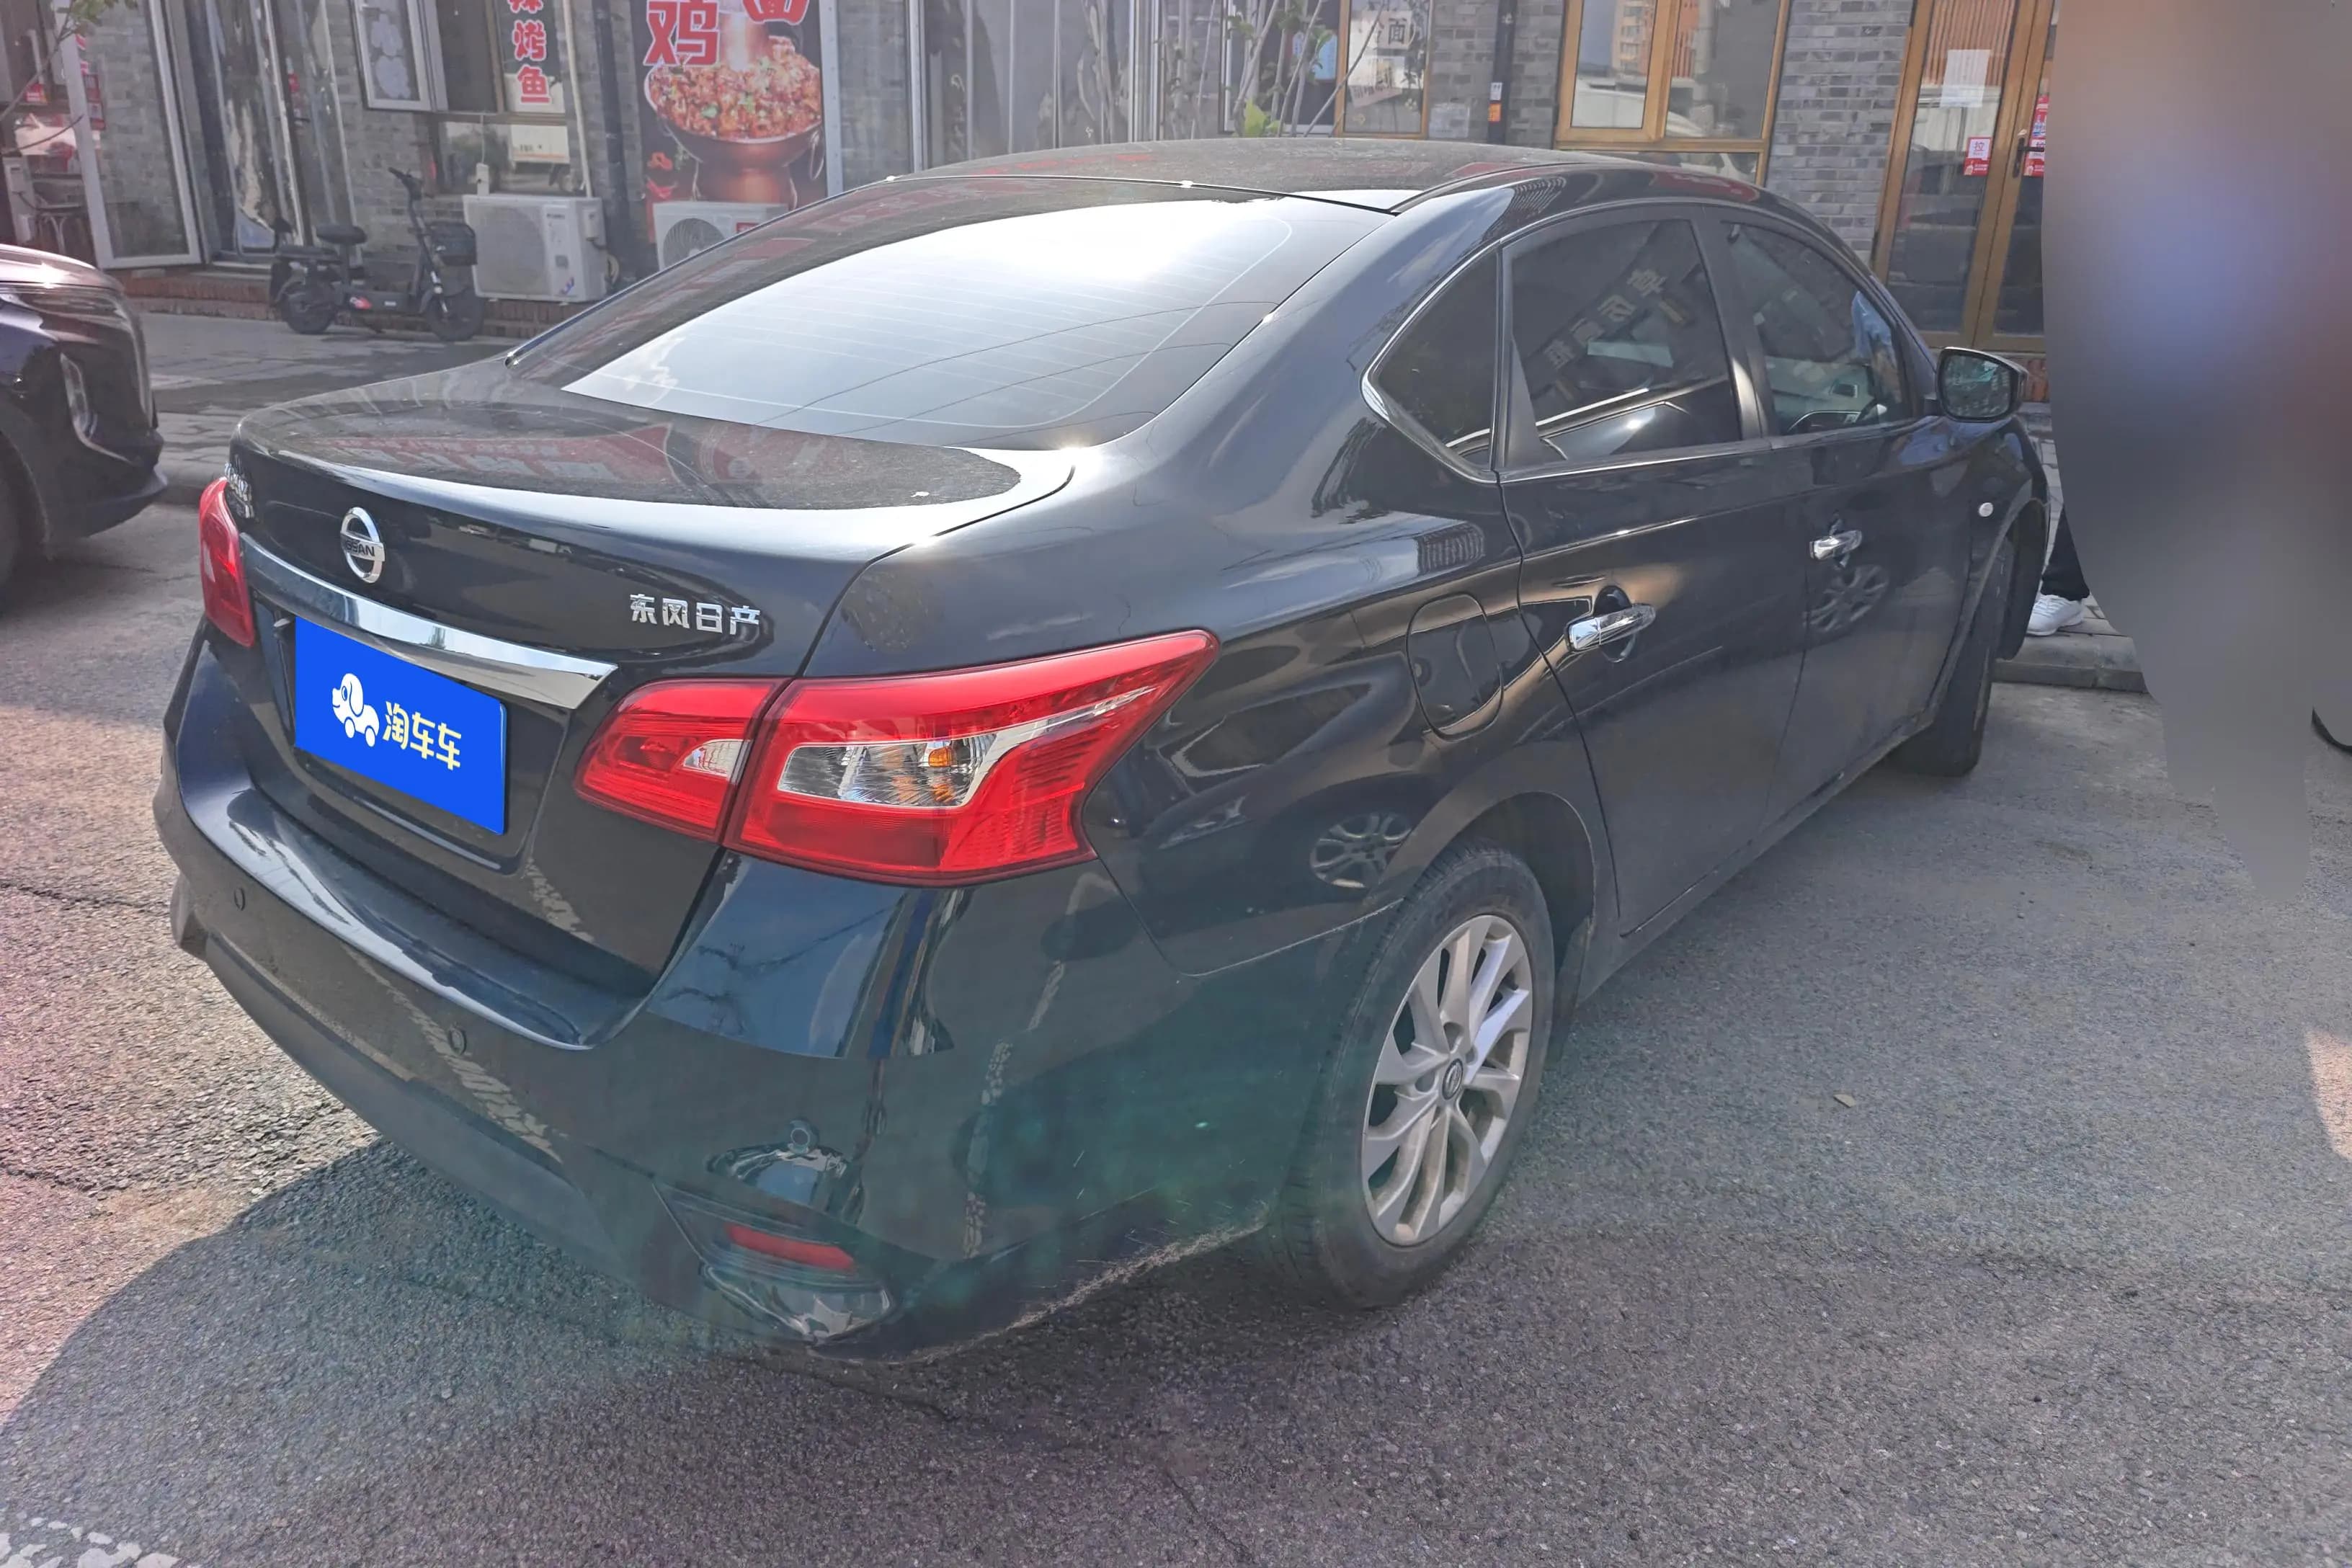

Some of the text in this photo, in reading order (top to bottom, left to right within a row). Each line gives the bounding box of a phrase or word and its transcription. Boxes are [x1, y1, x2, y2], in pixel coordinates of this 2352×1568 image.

[643, 0, 719, 66] 鸡
[1974, 141, 1985, 151] 拉
[630, 594, 761, 635] 东风日产
